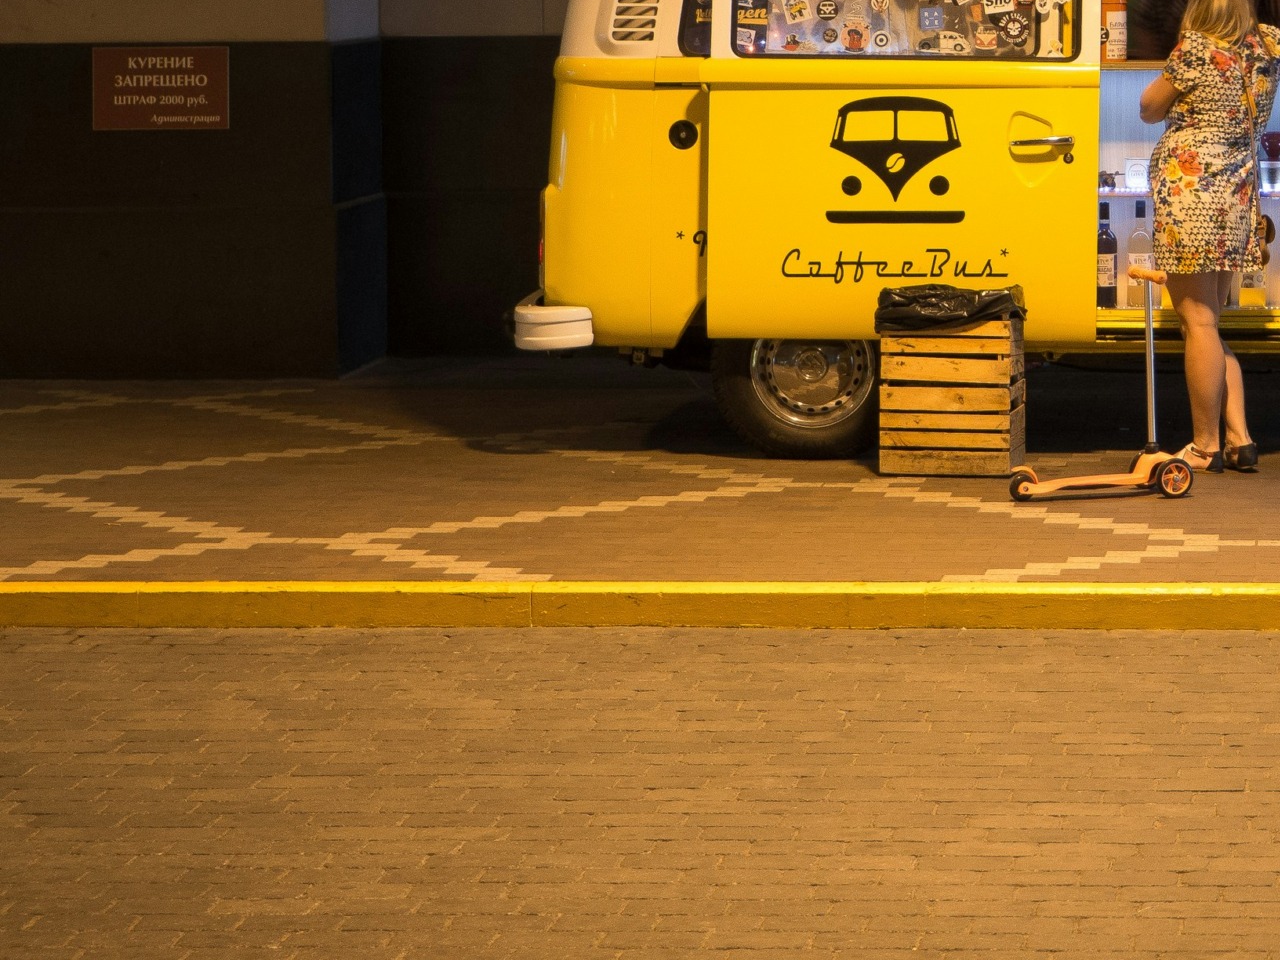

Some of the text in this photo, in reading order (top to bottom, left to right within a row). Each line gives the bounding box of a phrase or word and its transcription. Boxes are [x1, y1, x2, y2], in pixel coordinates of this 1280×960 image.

[128, 56, 194, 69] КУРЕНИЕ
[114, 74, 208, 88] ЗАПРЕЩЕНО
[114, 95, 208, 108] ШТРАФ 2000 руб.
[150, 114, 221, 125] Администрация
